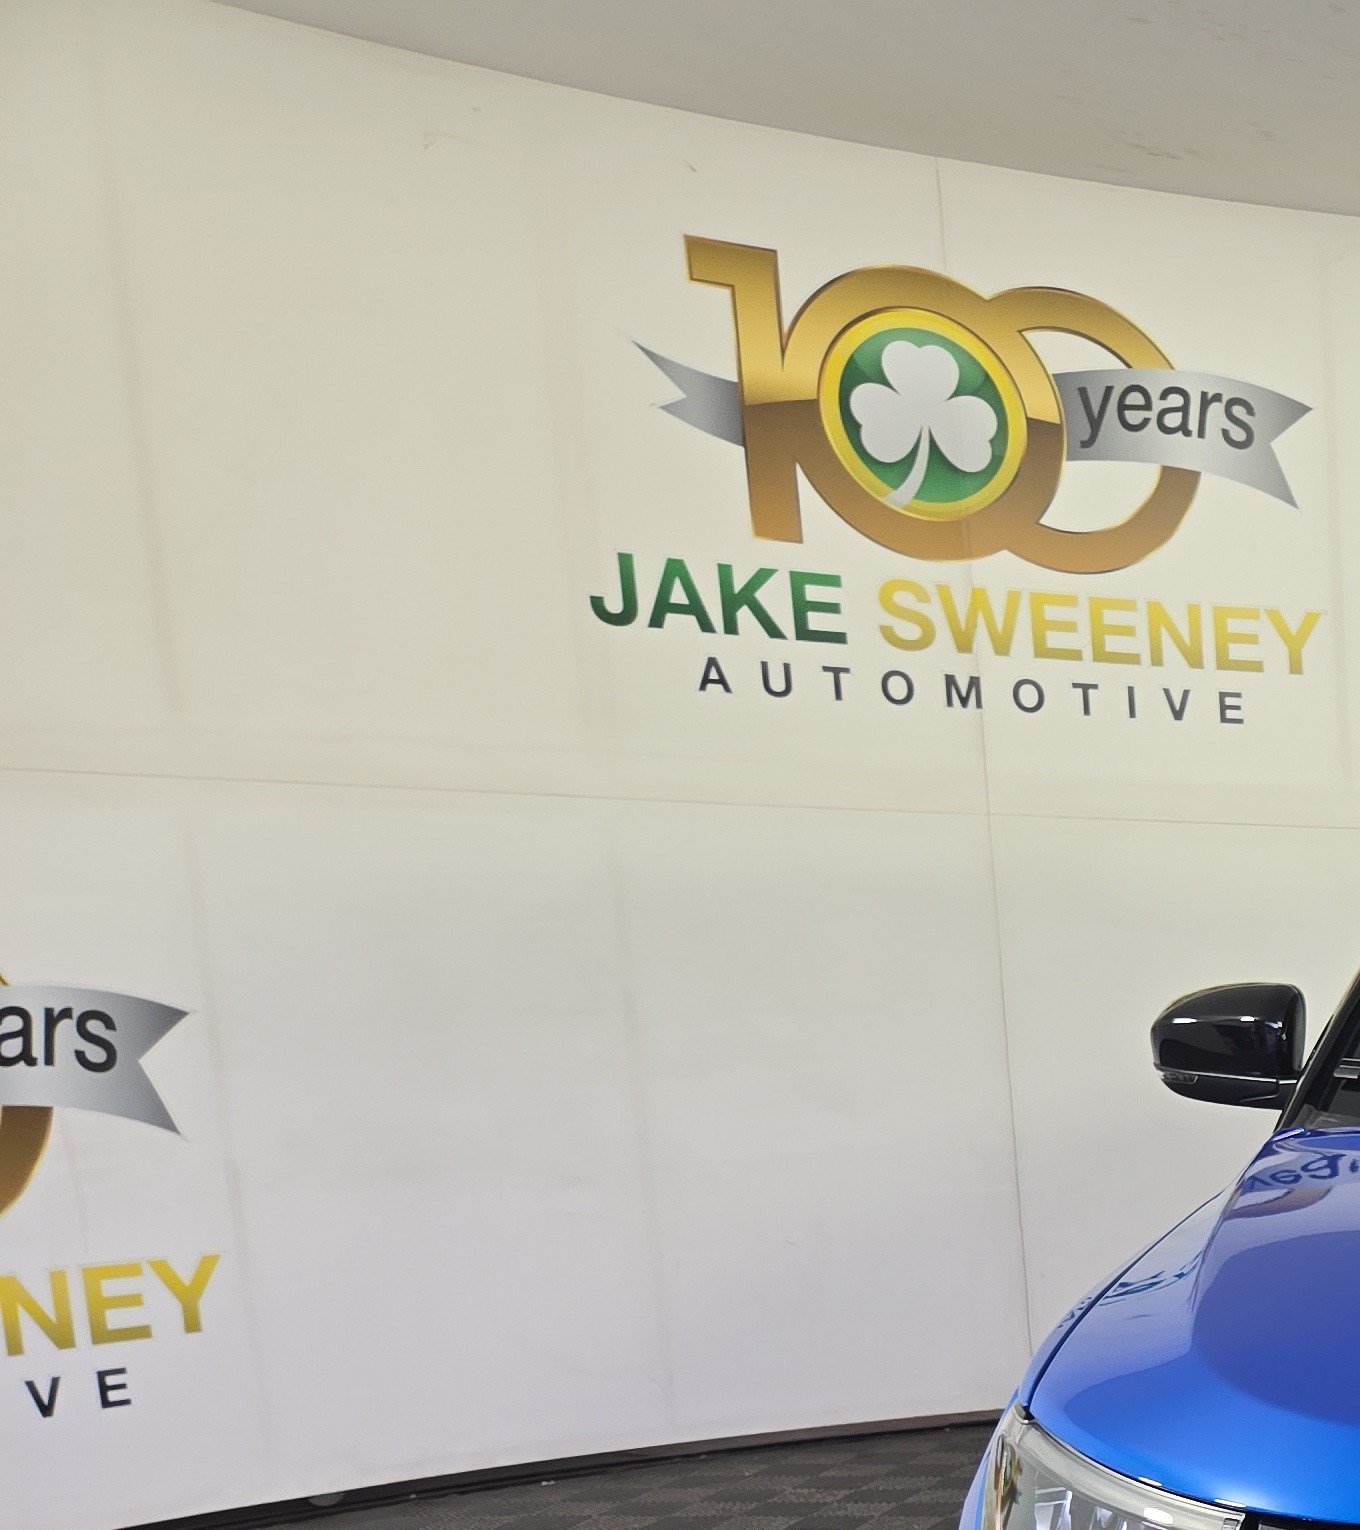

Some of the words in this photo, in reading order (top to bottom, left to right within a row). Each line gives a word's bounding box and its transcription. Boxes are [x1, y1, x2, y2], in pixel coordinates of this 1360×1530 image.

[683, 234, 1202, 574] 100
[1077, 376, 1257, 450] years
[589, 552, 849, 645] JAKE
[877, 578, 1325, 676] SWEENEY
[698, 656, 1246, 725] AUTOMOTIVE
